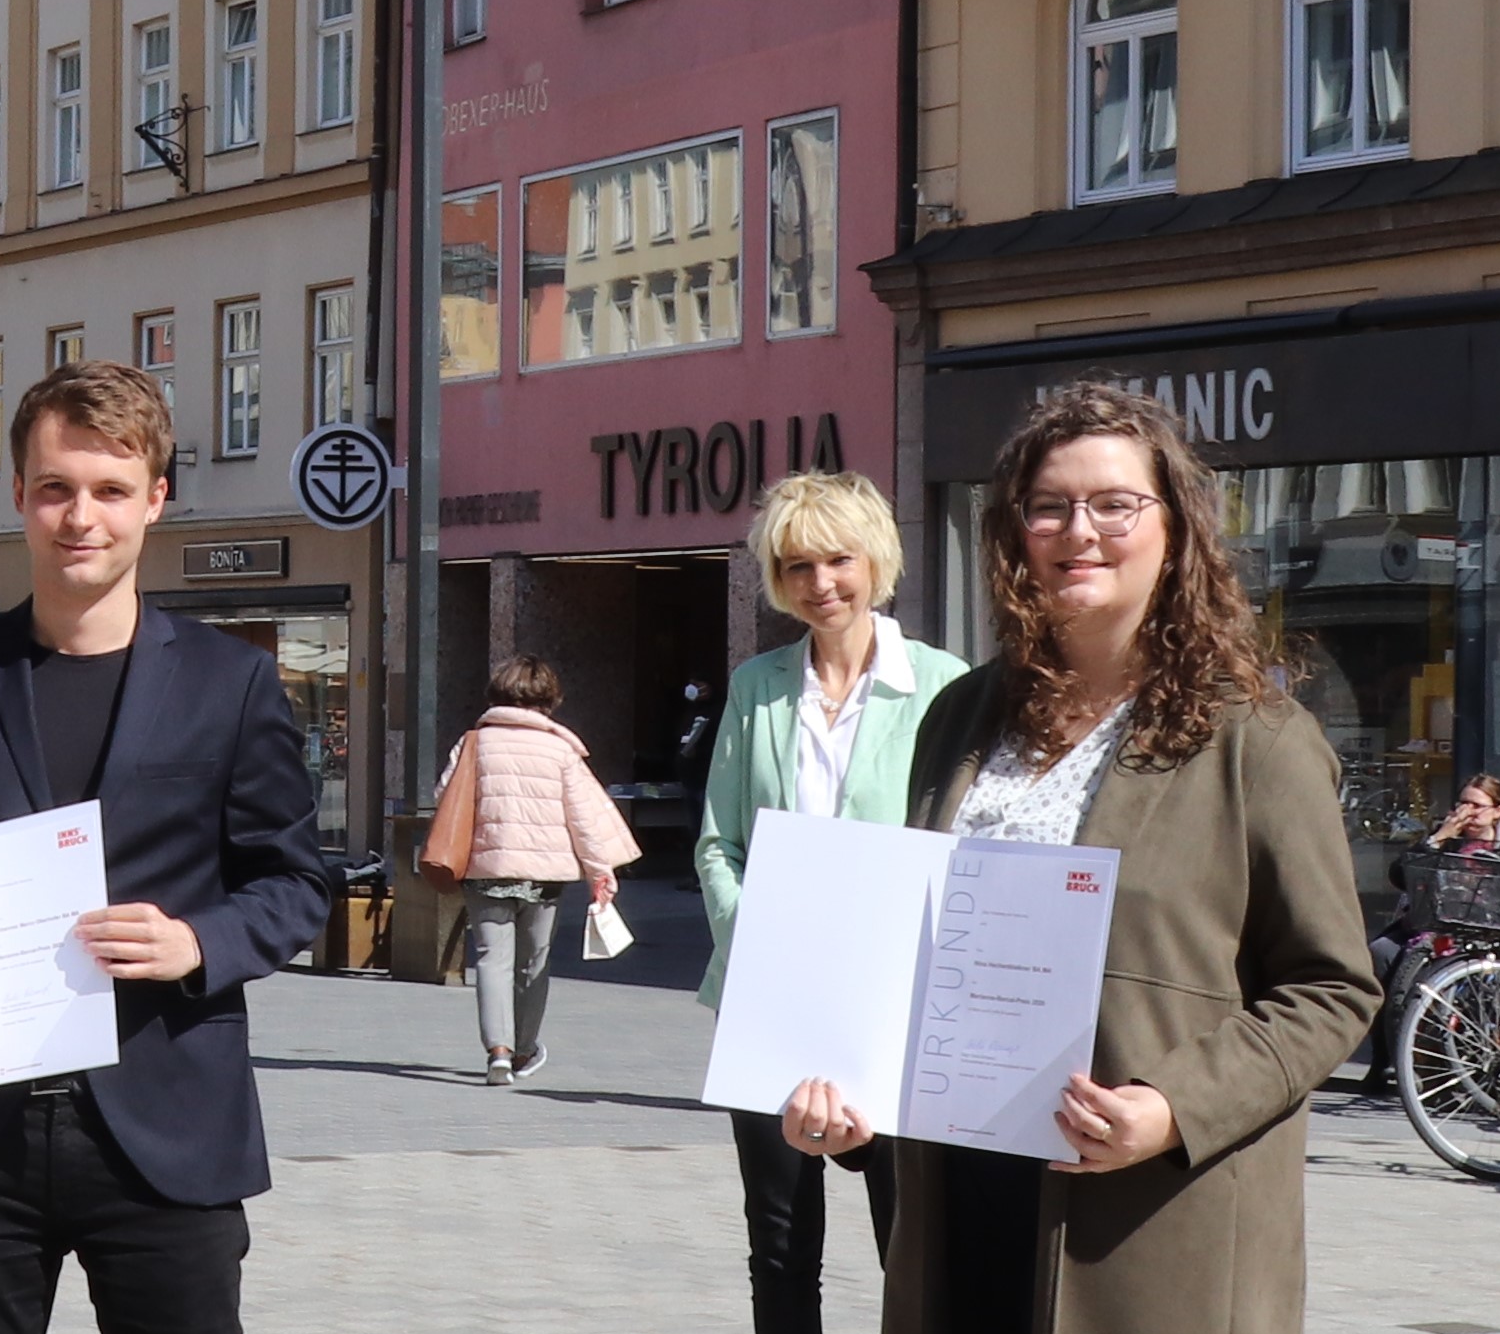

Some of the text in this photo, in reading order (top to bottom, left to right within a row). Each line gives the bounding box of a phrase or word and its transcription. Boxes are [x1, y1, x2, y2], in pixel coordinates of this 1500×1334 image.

[1036, 368, 1274, 442] ANIC
[58, 836, 89, 849] BRUCK
[1065, 881, 1101, 894] BRUCK
[919, 858, 983, 1096] URKUNDE
